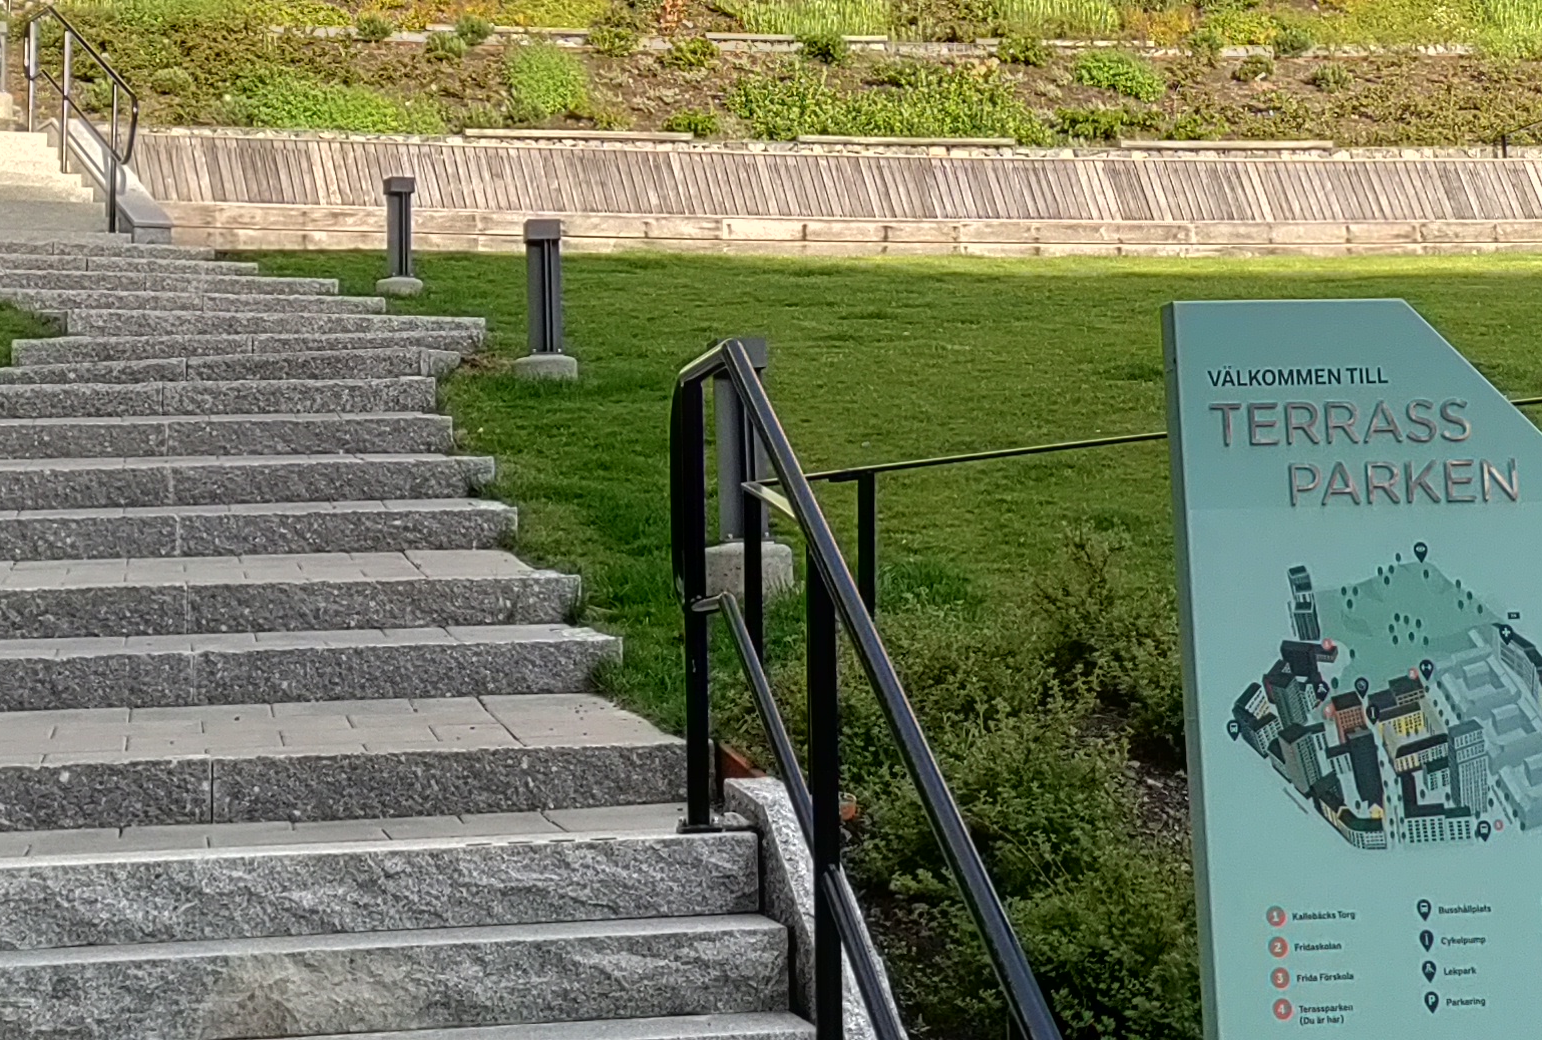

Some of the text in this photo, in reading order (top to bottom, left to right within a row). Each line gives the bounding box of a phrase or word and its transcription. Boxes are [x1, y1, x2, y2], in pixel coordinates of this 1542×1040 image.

[1207, 365, 1389, 387] VÄLKOMMEN TILL
[1209, 398, 1472, 447] TERRASS
[1288, 456, 1520, 507] PARKEN
[1337, 911, 1356, 920] Torg
[1294, 941, 1342, 951] Fridaskolan
[1443, 967, 1477, 976] Lekpark
[1296, 974, 1318, 982] Frida
[1446, 998, 1486, 1007] Parkering
